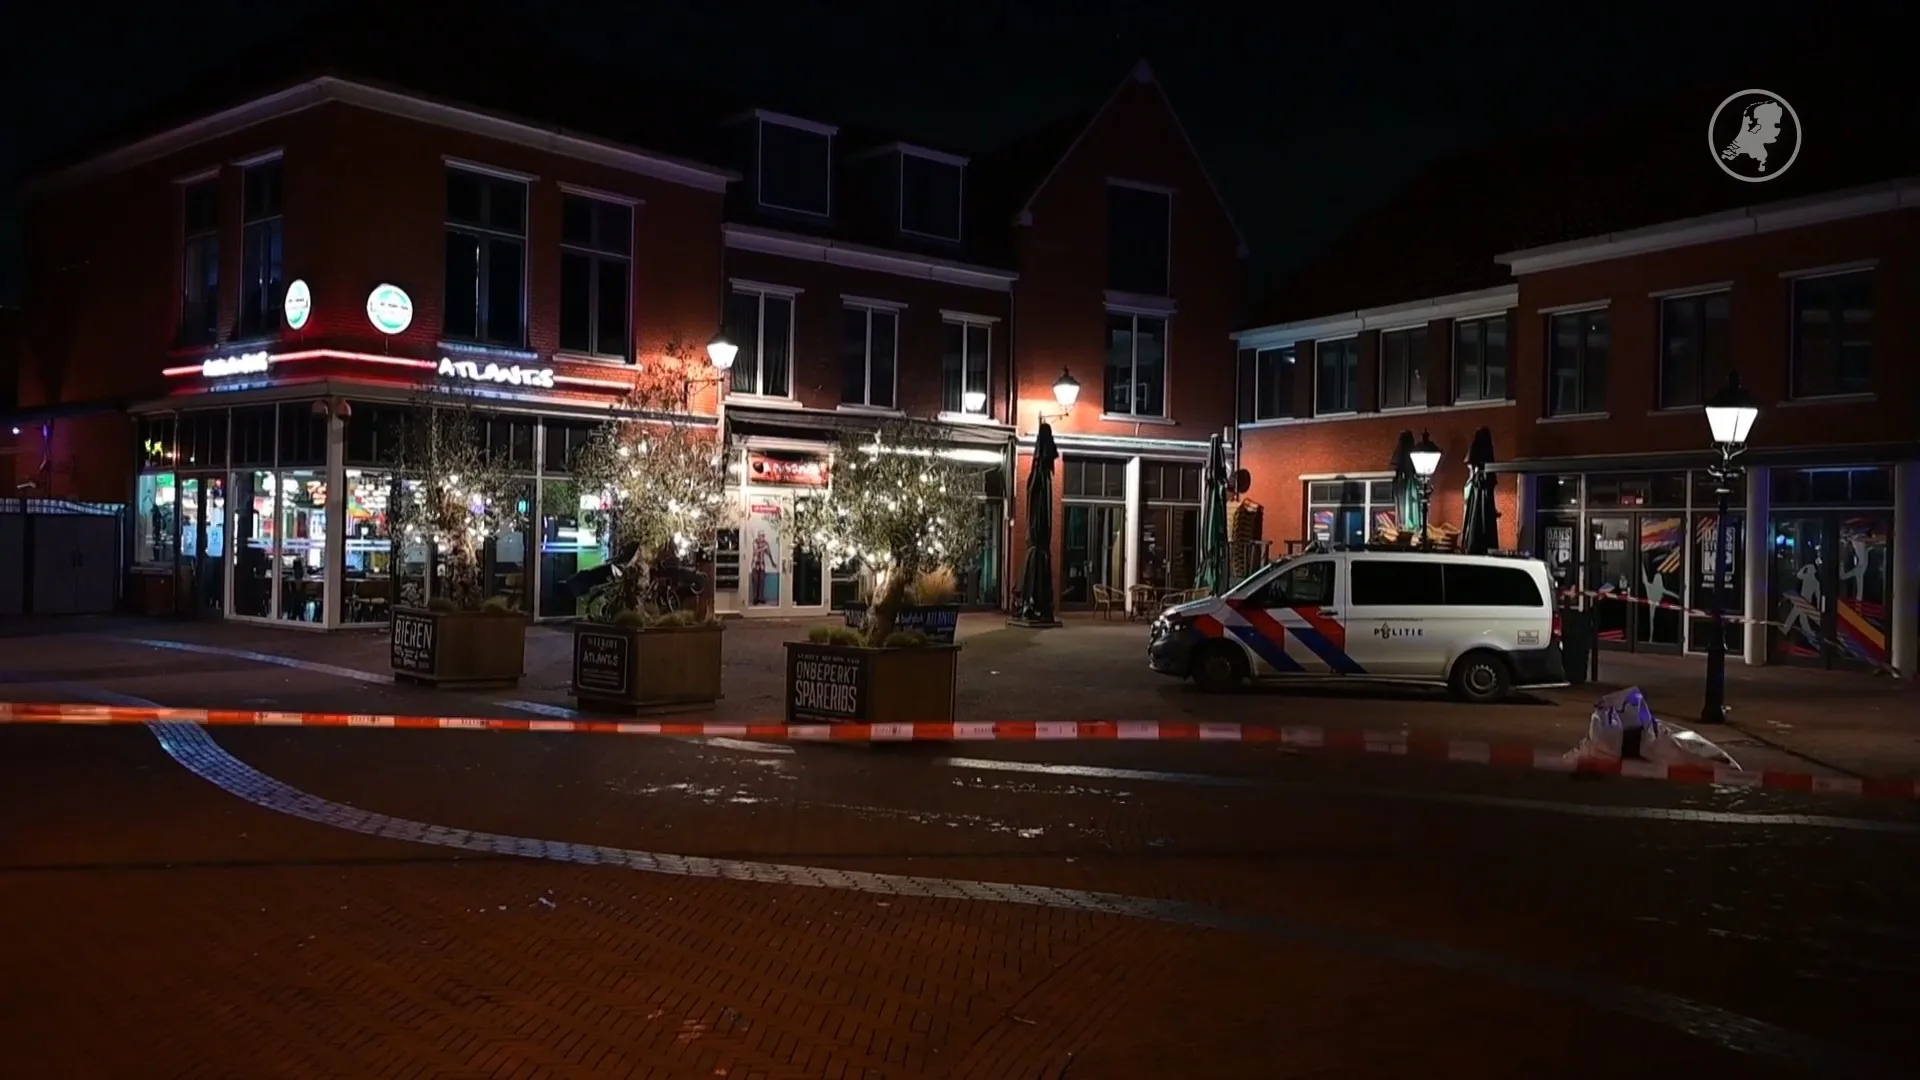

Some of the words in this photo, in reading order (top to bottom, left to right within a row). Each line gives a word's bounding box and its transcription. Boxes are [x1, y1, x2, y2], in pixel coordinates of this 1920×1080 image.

[1595, 539, 1625, 551] INGANG
[394, 618, 433, 650] BIEREN
[796, 660, 859, 685] ONBEPERKT
[795, 679, 857, 713] SPARERIBS
